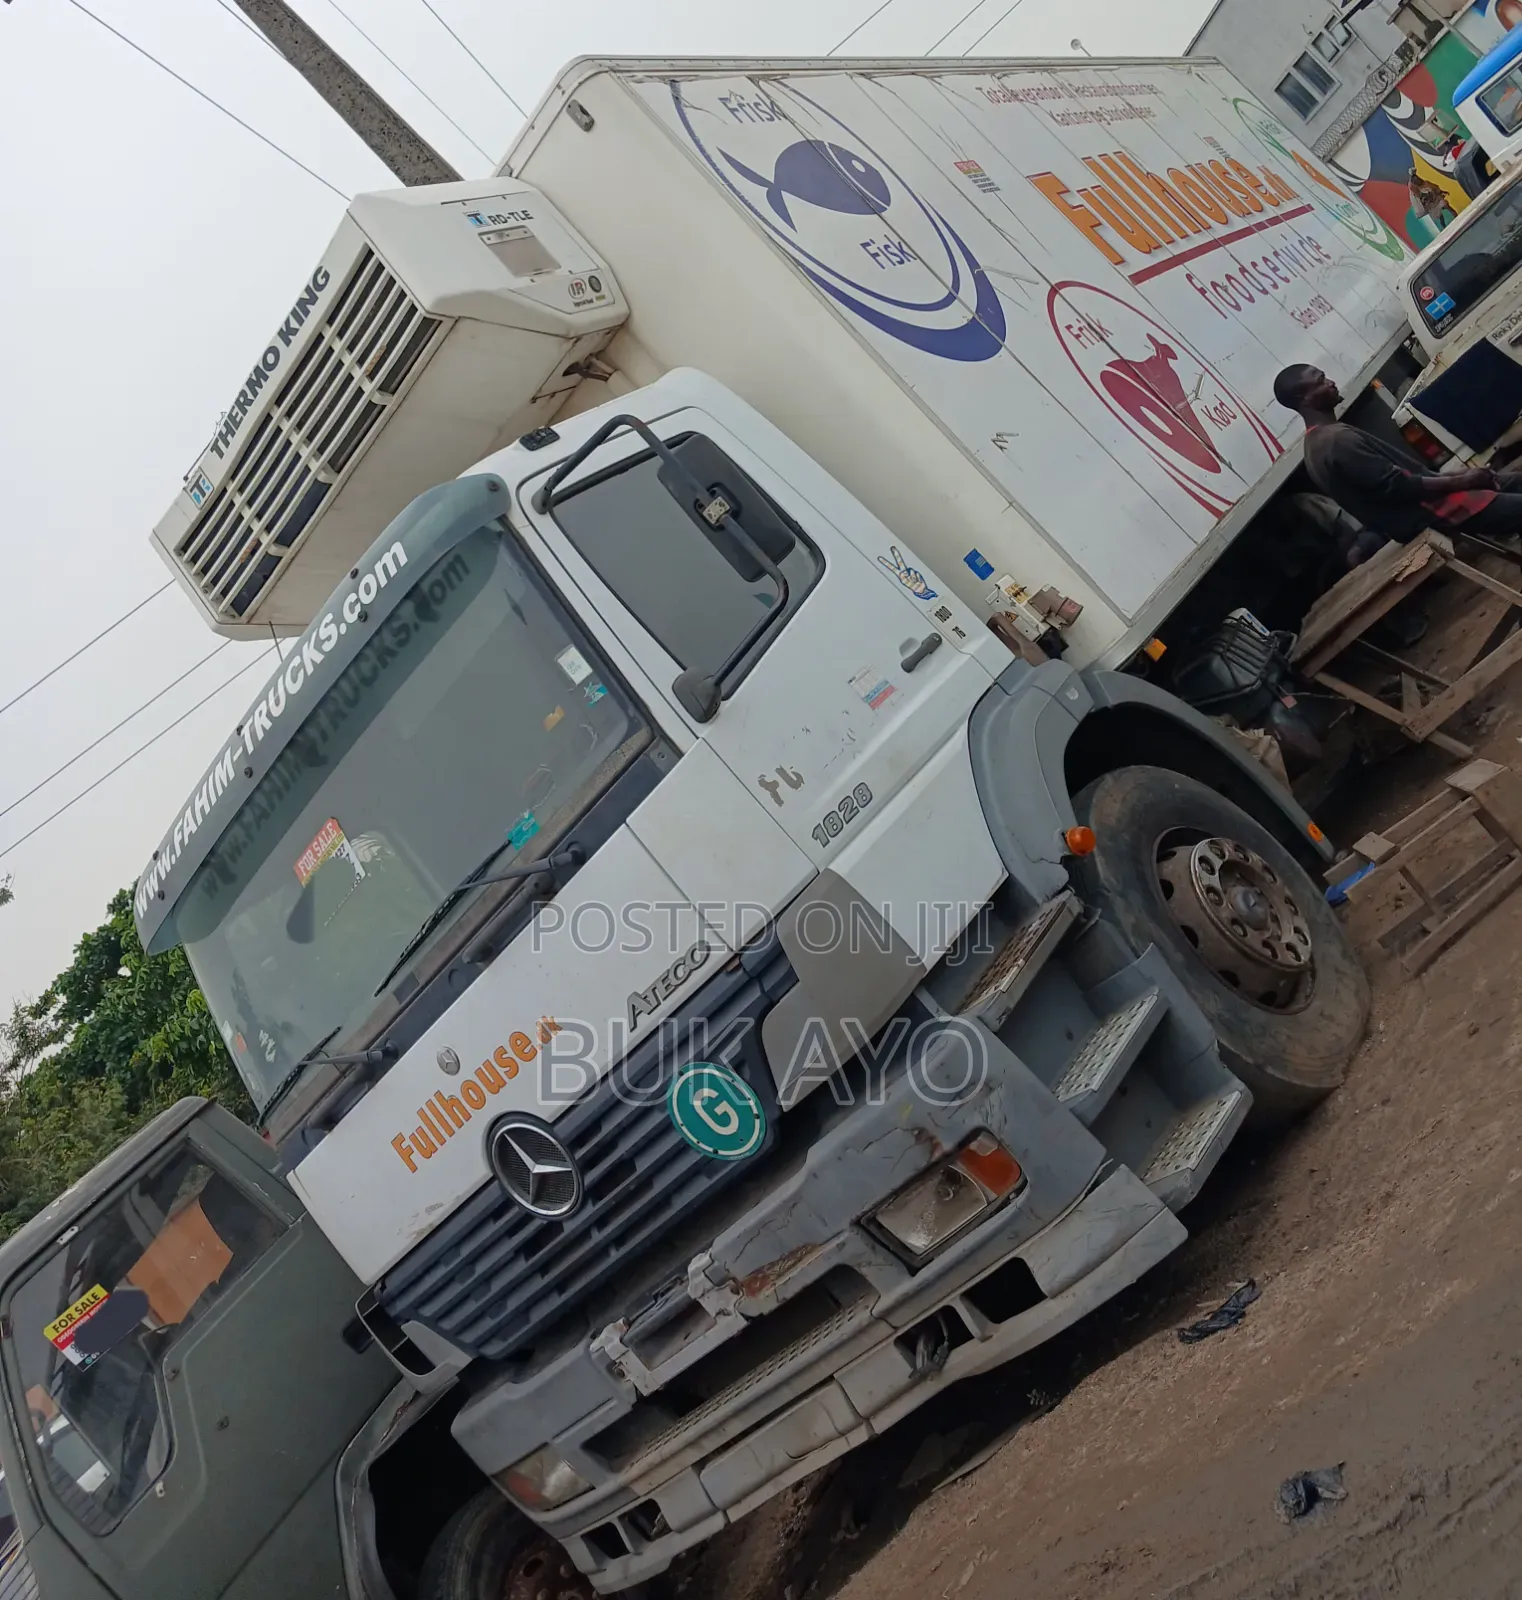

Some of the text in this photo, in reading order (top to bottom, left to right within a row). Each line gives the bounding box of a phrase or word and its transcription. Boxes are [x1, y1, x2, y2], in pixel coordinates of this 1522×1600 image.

[718, 93, 786, 124] Frisk
[488, 209, 534, 225] RD-TLE
[1026, 151, 1300, 266] Fullhouse.dk
[860, 236, 916, 270] Fisk
[210, 266, 330, 460] THERMO KING
[1201, 399, 1237, 431] Kød
[811, 782, 873, 848] 1828
[298, 849, 316, 877] FOR
[312, 822, 337, 857] SALE
[391, 1015, 563, 1173] Fullhouse.dk
[693, 1088, 739, 1135] G
[52, 1292, 100, 1333] FOR SALE
